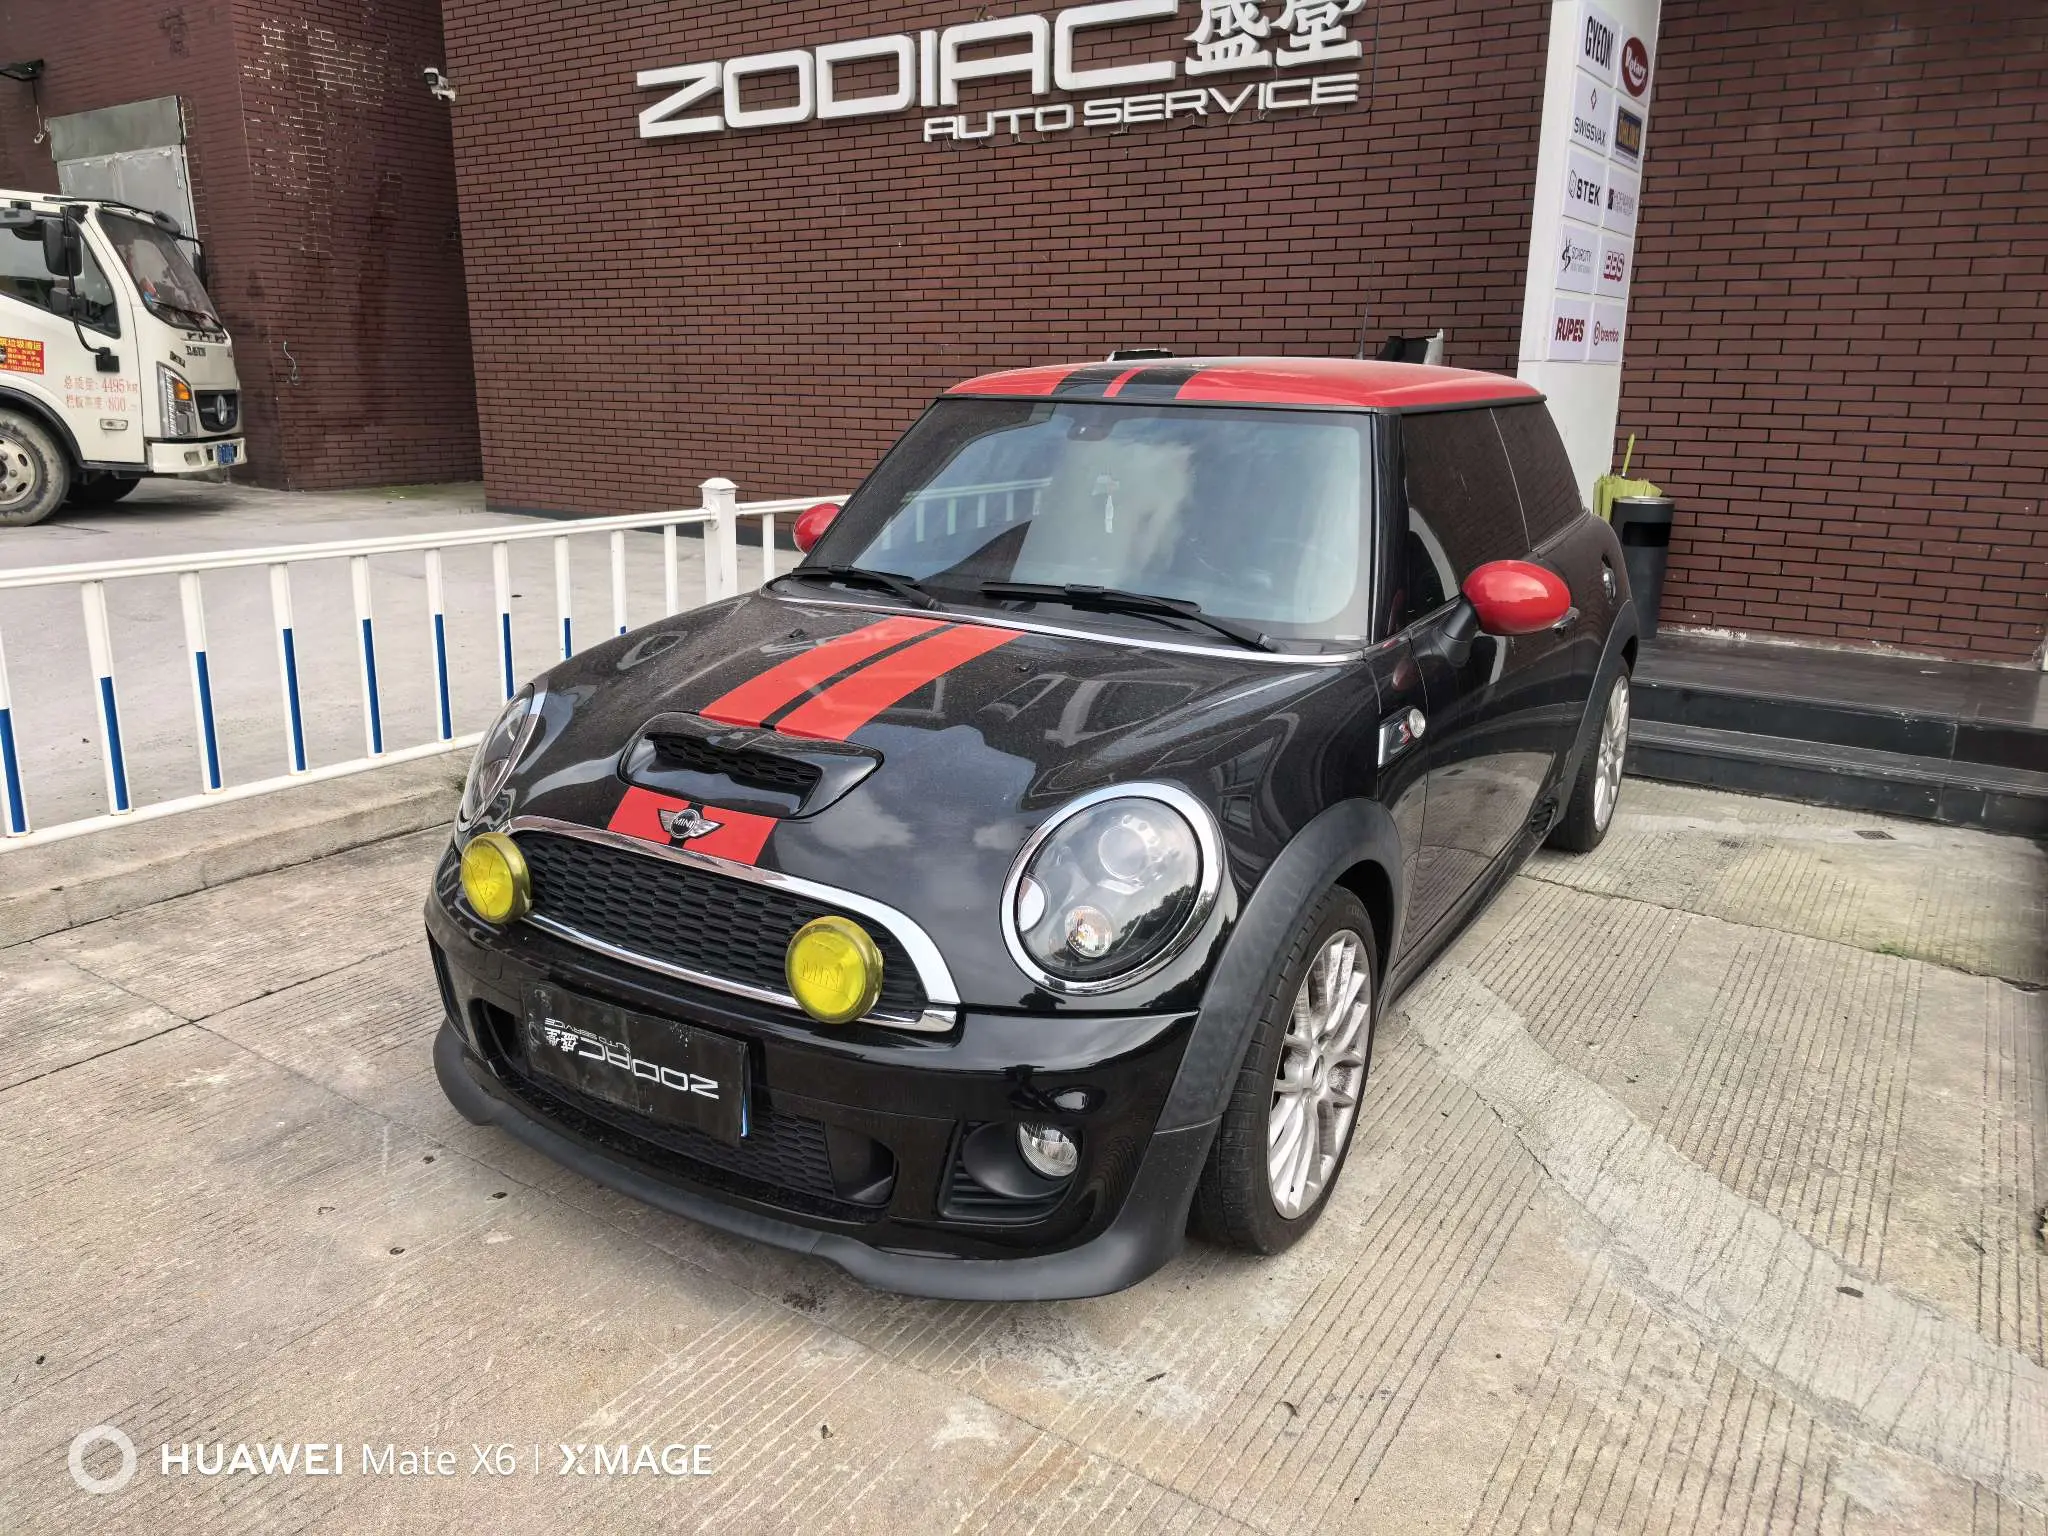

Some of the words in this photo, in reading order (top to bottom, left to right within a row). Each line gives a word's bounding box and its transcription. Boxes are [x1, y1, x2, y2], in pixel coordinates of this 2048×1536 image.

[1184, 0, 1366, 76] 盛堂
[1585, 15, 1614, 71] GYEON
[635, 0, 1179, 140] ZODIAC
[923, 103, 1075, 143] AUTO
[1083, 72, 1361, 127] SERVICE
[1576, 177, 1601, 207] STEK
[1603, 250, 1625, 282] BBS
[1555, 316, 1585, 343] RUPES
[674, 817, 695, 829] MINI
[544, 1017, 598, 1041] SERVICE
[579, 1036, 720, 1100] ZODIAC
